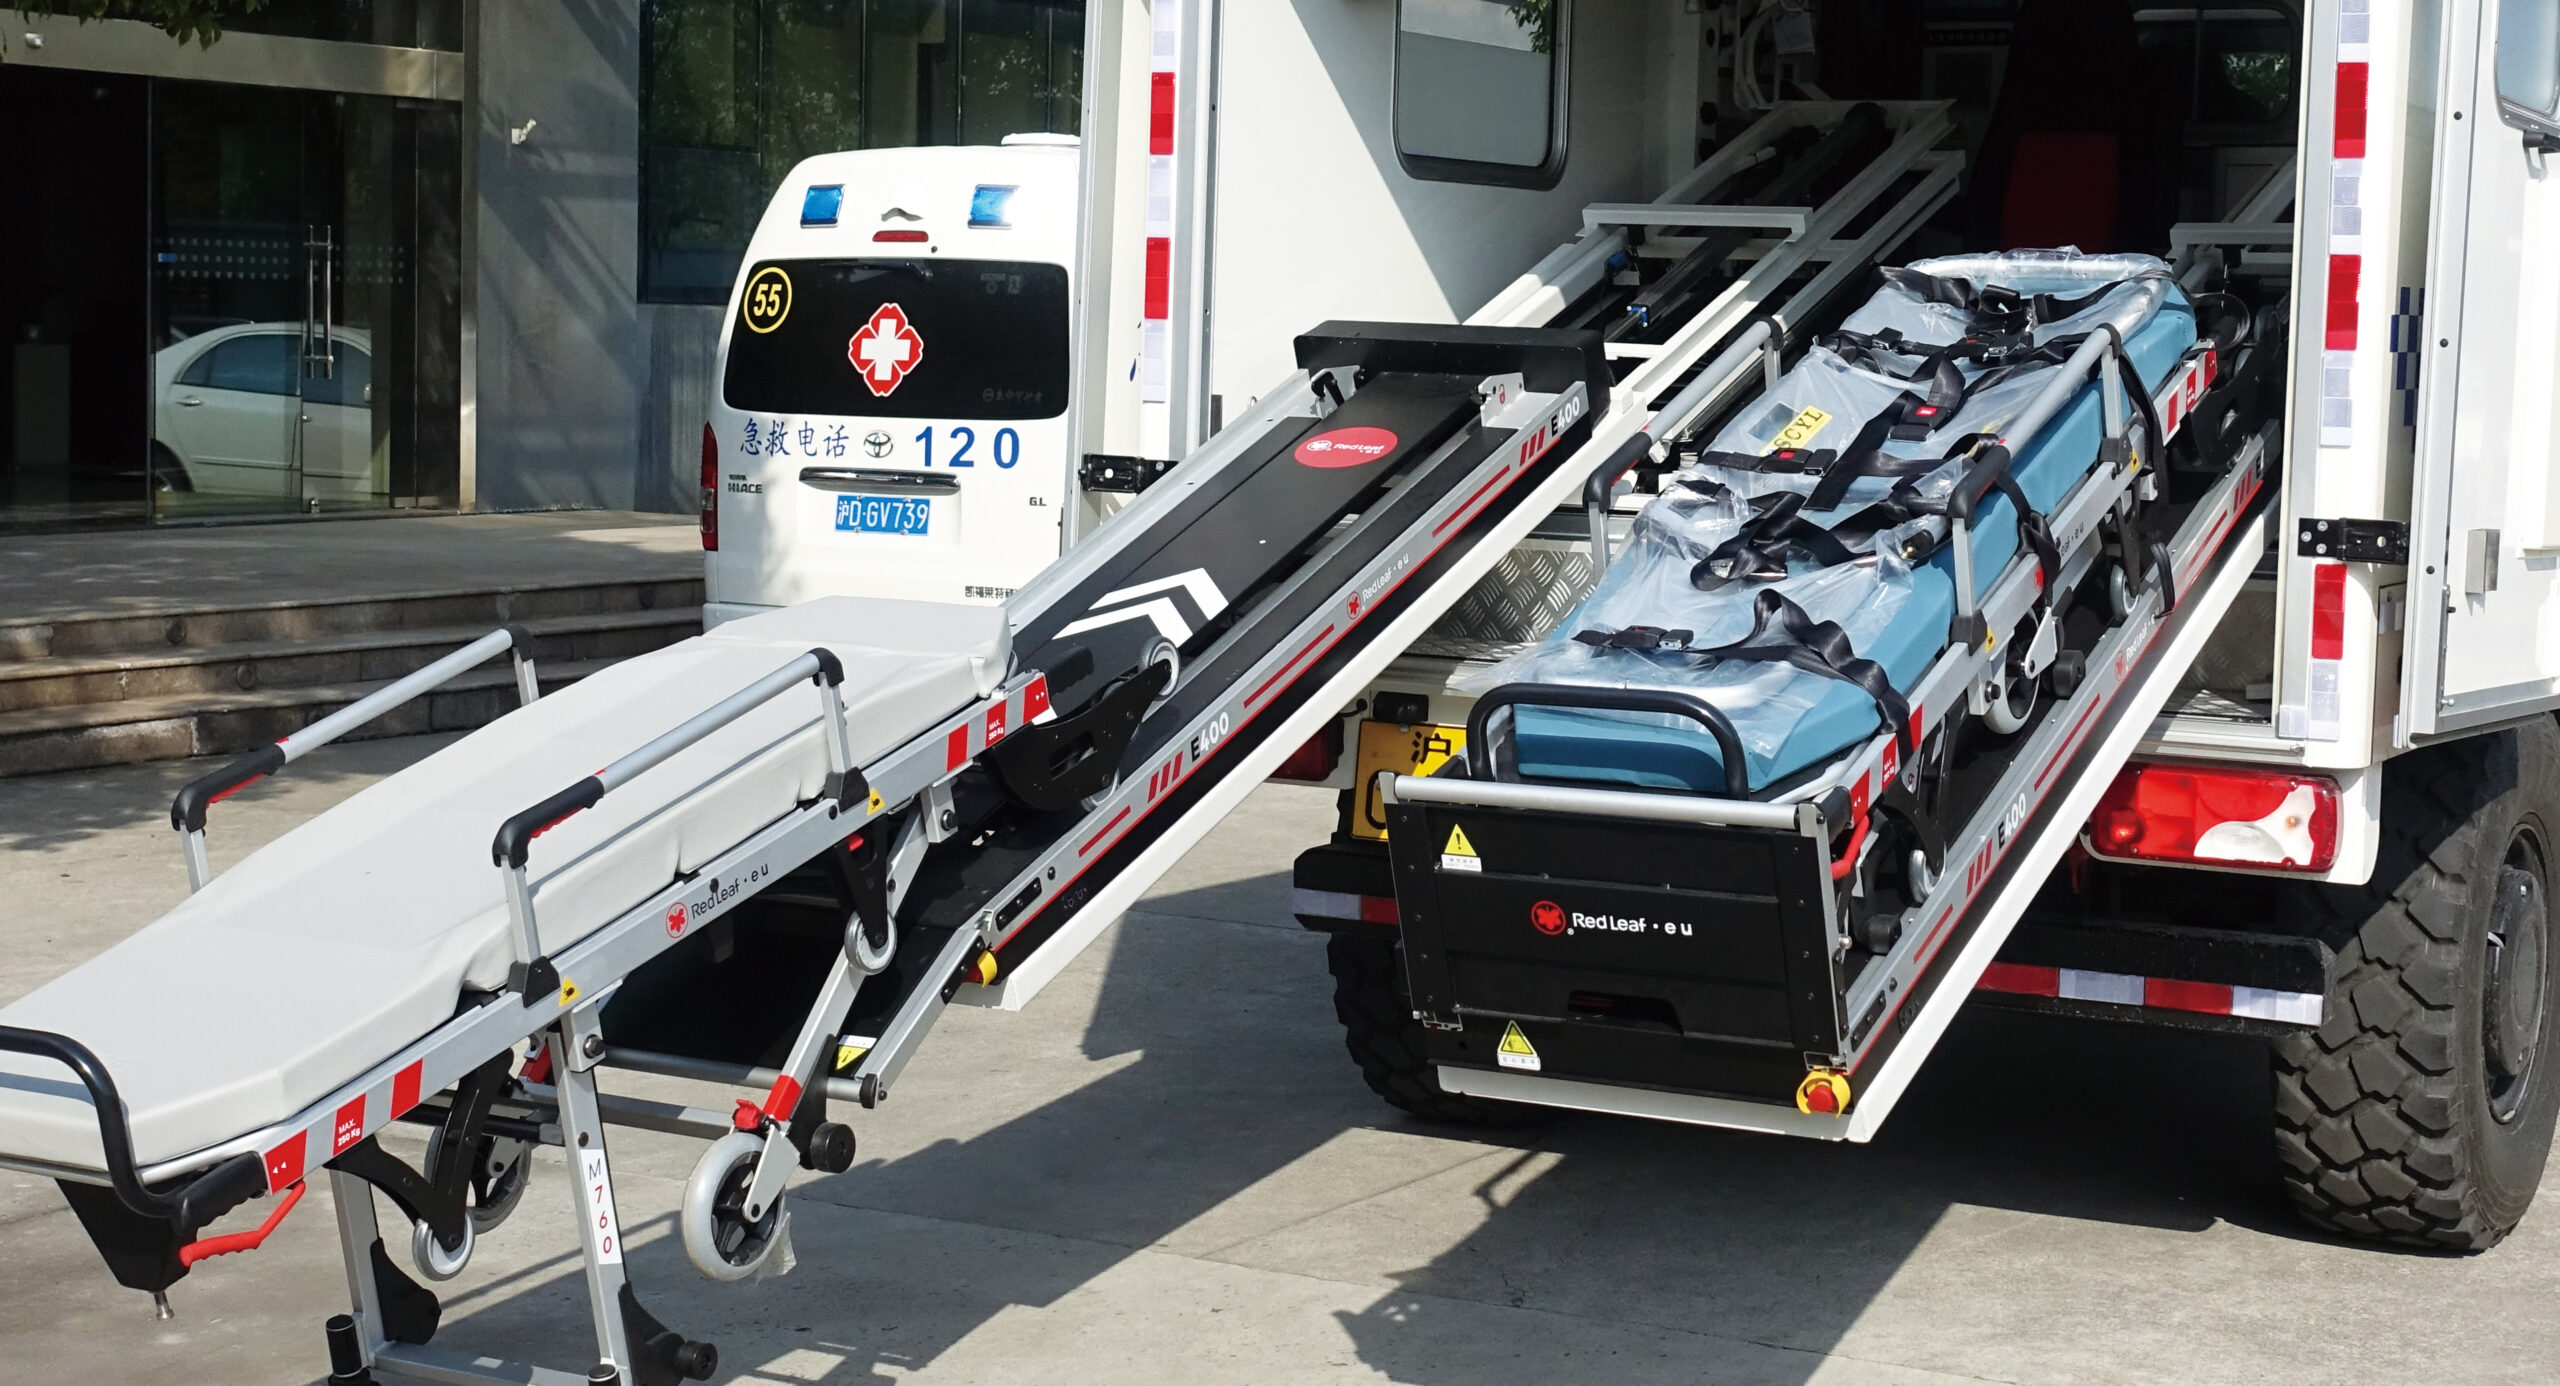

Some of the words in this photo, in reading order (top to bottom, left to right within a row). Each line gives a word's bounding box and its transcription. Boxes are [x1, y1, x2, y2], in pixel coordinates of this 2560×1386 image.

[753, 283, 783, 317] 55
[1551, 396, 1580, 437] E400
[740, 418, 850, 459] 急救电话
[915, 426, 1020, 469] 120
[728, 482, 763, 494] HIACE
[965, 585, 1018, 599] 凯福莱特种
[1191, 711, 1229, 763] E400
[1410, 731, 1452, 764] 沪
[1998, 792, 2026, 851] E400
